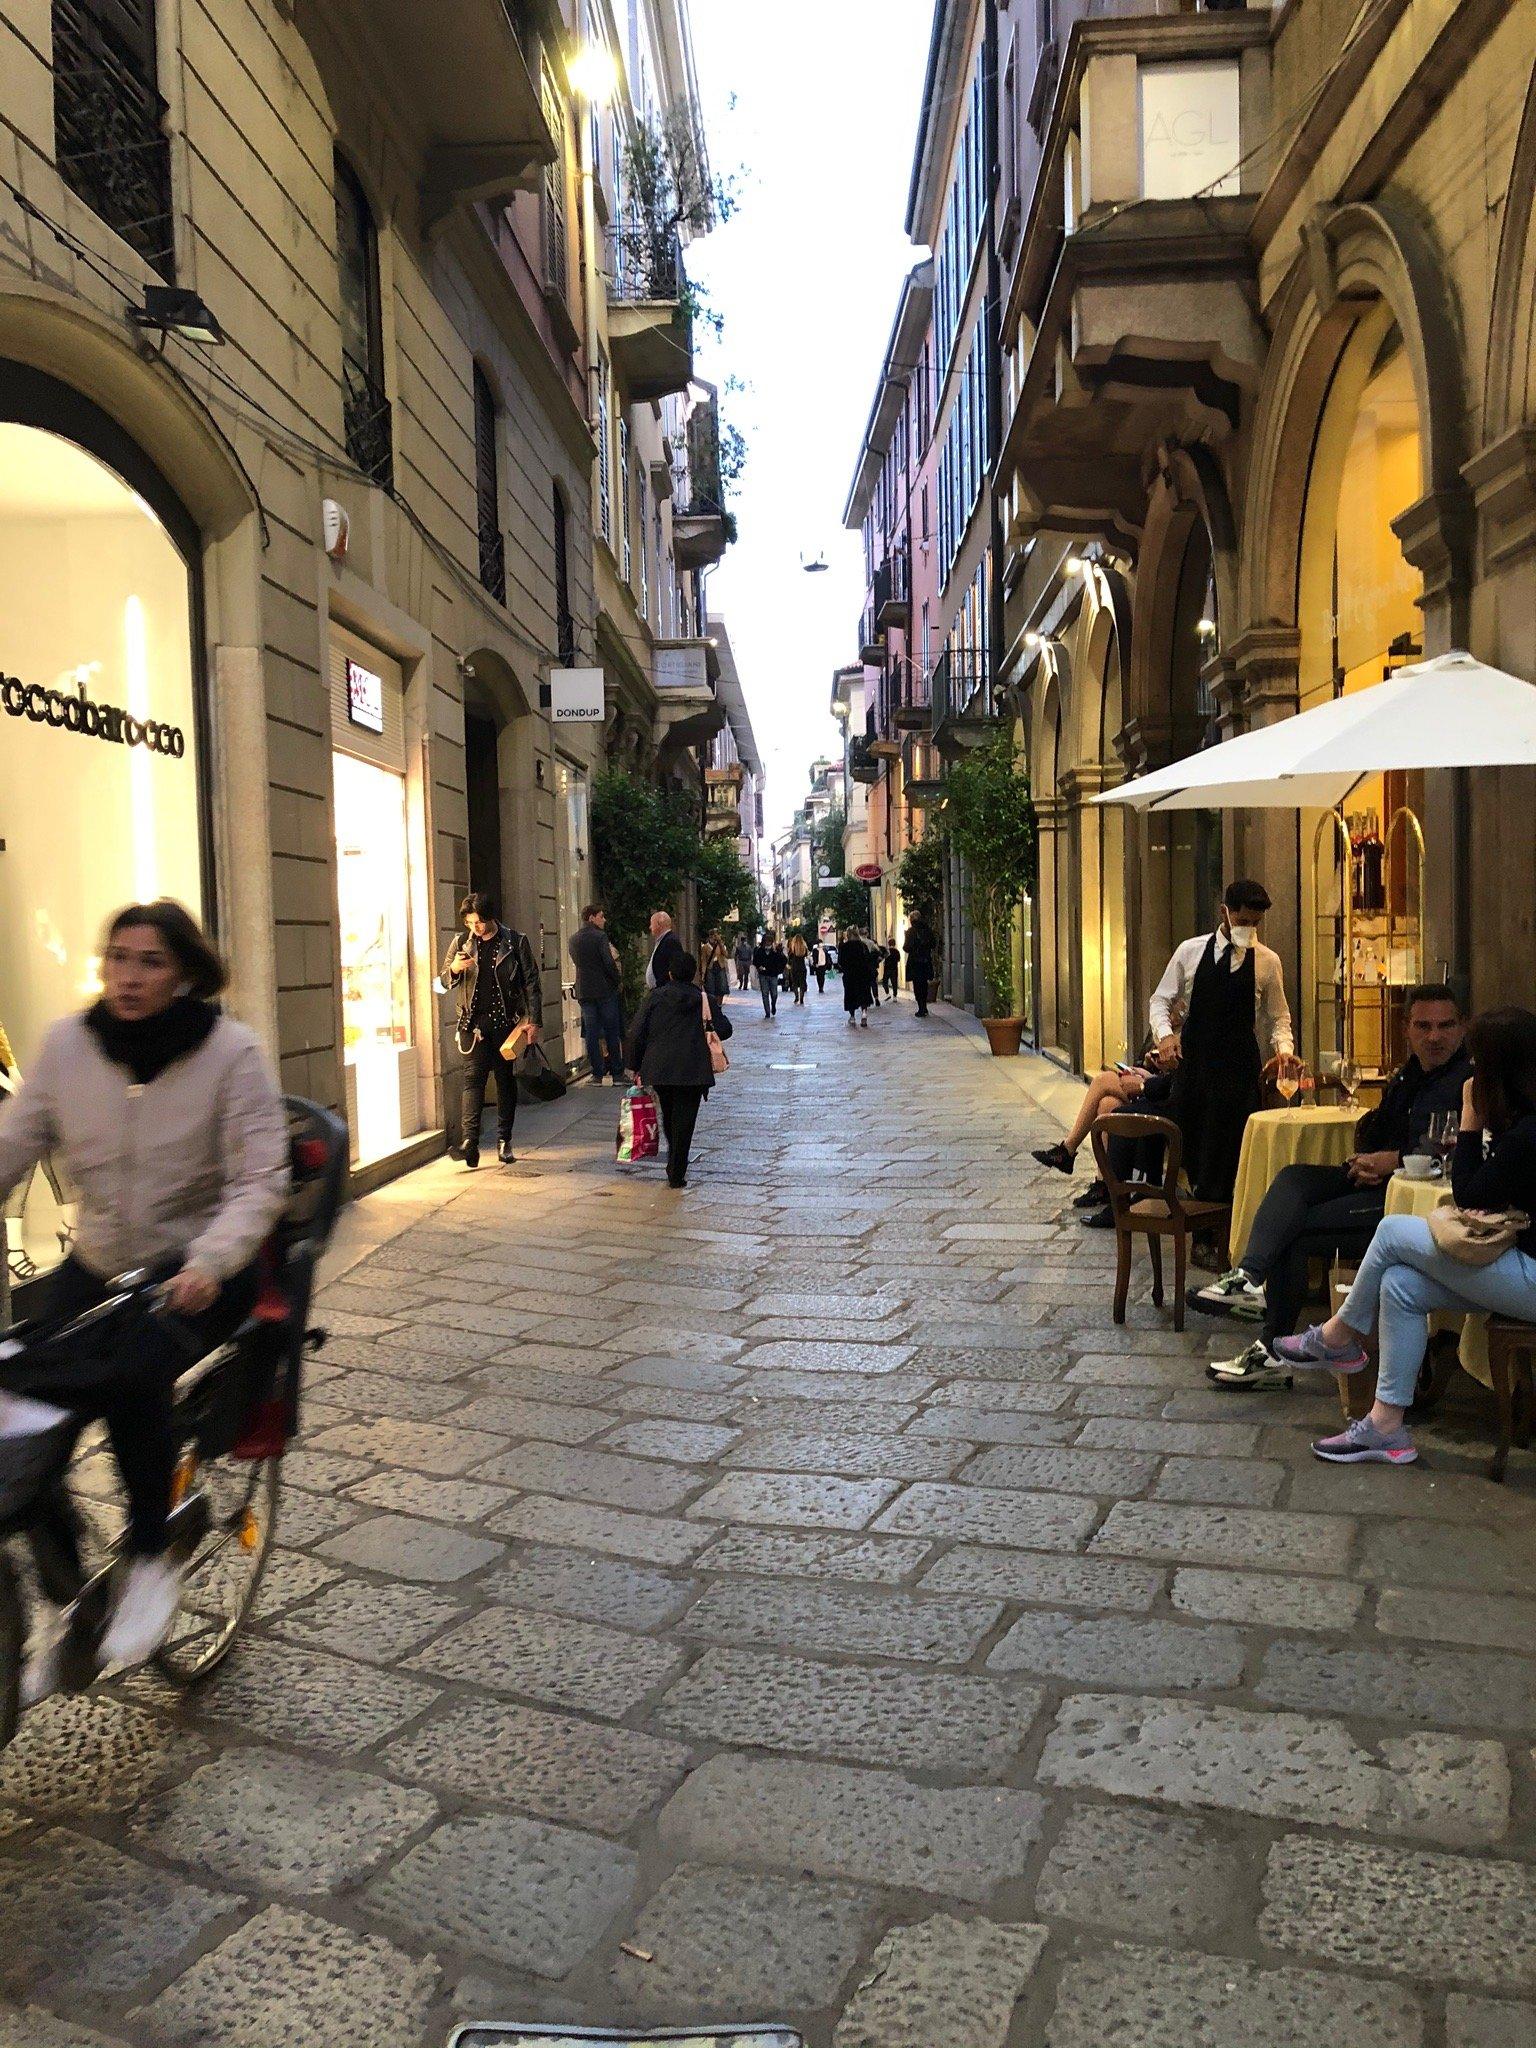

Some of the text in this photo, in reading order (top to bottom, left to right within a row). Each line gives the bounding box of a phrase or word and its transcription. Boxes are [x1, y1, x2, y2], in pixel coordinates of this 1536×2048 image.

[1147, 110, 1229, 147] AGL
[0, 672, 185, 759] occobarocco
[556, 708, 600, 718] DONDUP
